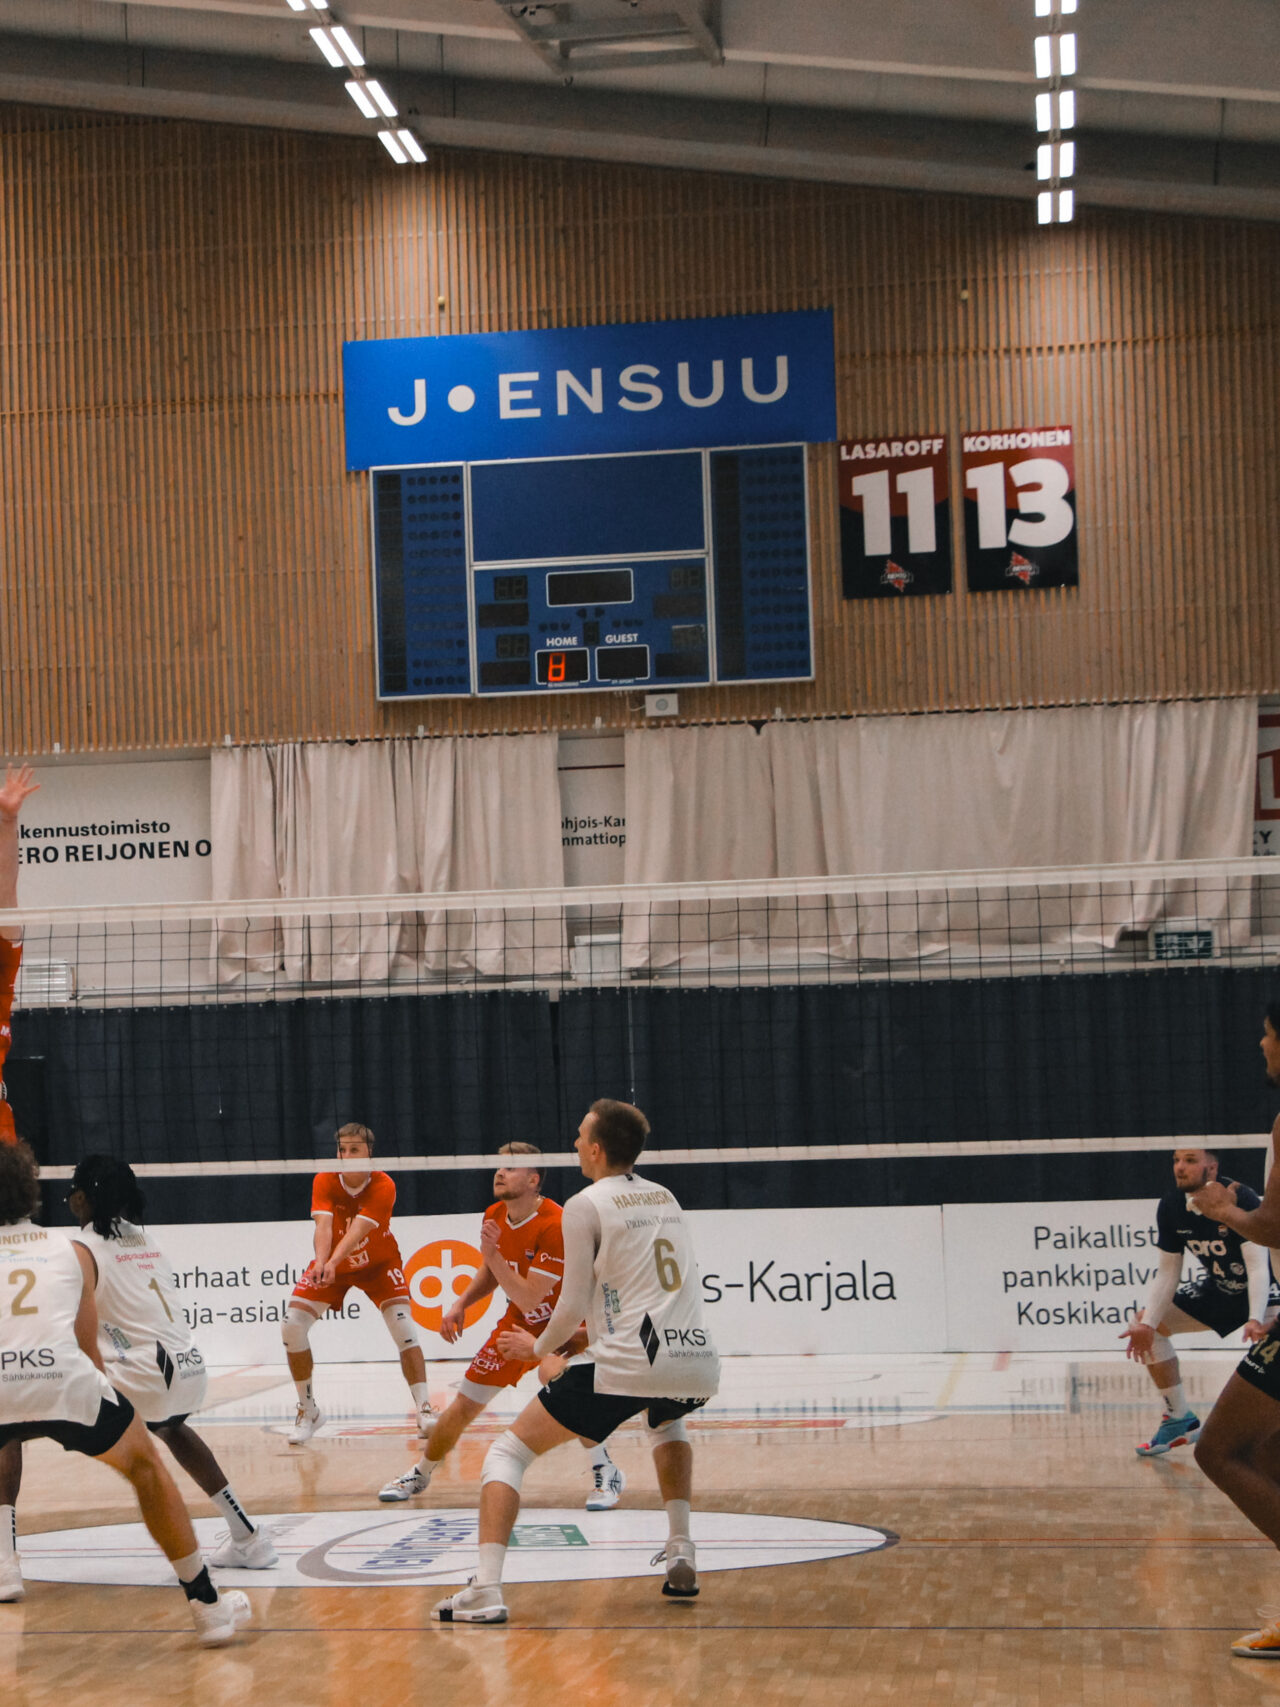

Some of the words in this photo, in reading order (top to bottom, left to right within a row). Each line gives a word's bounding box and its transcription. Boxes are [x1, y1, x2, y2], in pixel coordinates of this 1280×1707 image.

[840, 438, 944, 461] LASAROFF
[963, 429, 1070, 453] KORHONEN
[852, 466, 937, 556] 11
[966, 458, 1074, 550] 13
[546, 636, 578, 647] HOME
[605, 633, 639, 644] GUEST
[65, 840, 189, 863] REIJONEN
[1034, 1225, 1159, 1250] Paikallist
[387, 1268, 405, 1286] 19
[653, 1238, 682, 1293] 6
[1003, 1263, 1209, 1293] pankkipalvua
[664, 1328, 707, 1347] PKS
[1, 1347, 55, 1370] PKS
[176, 1347, 203, 1370] PKS
